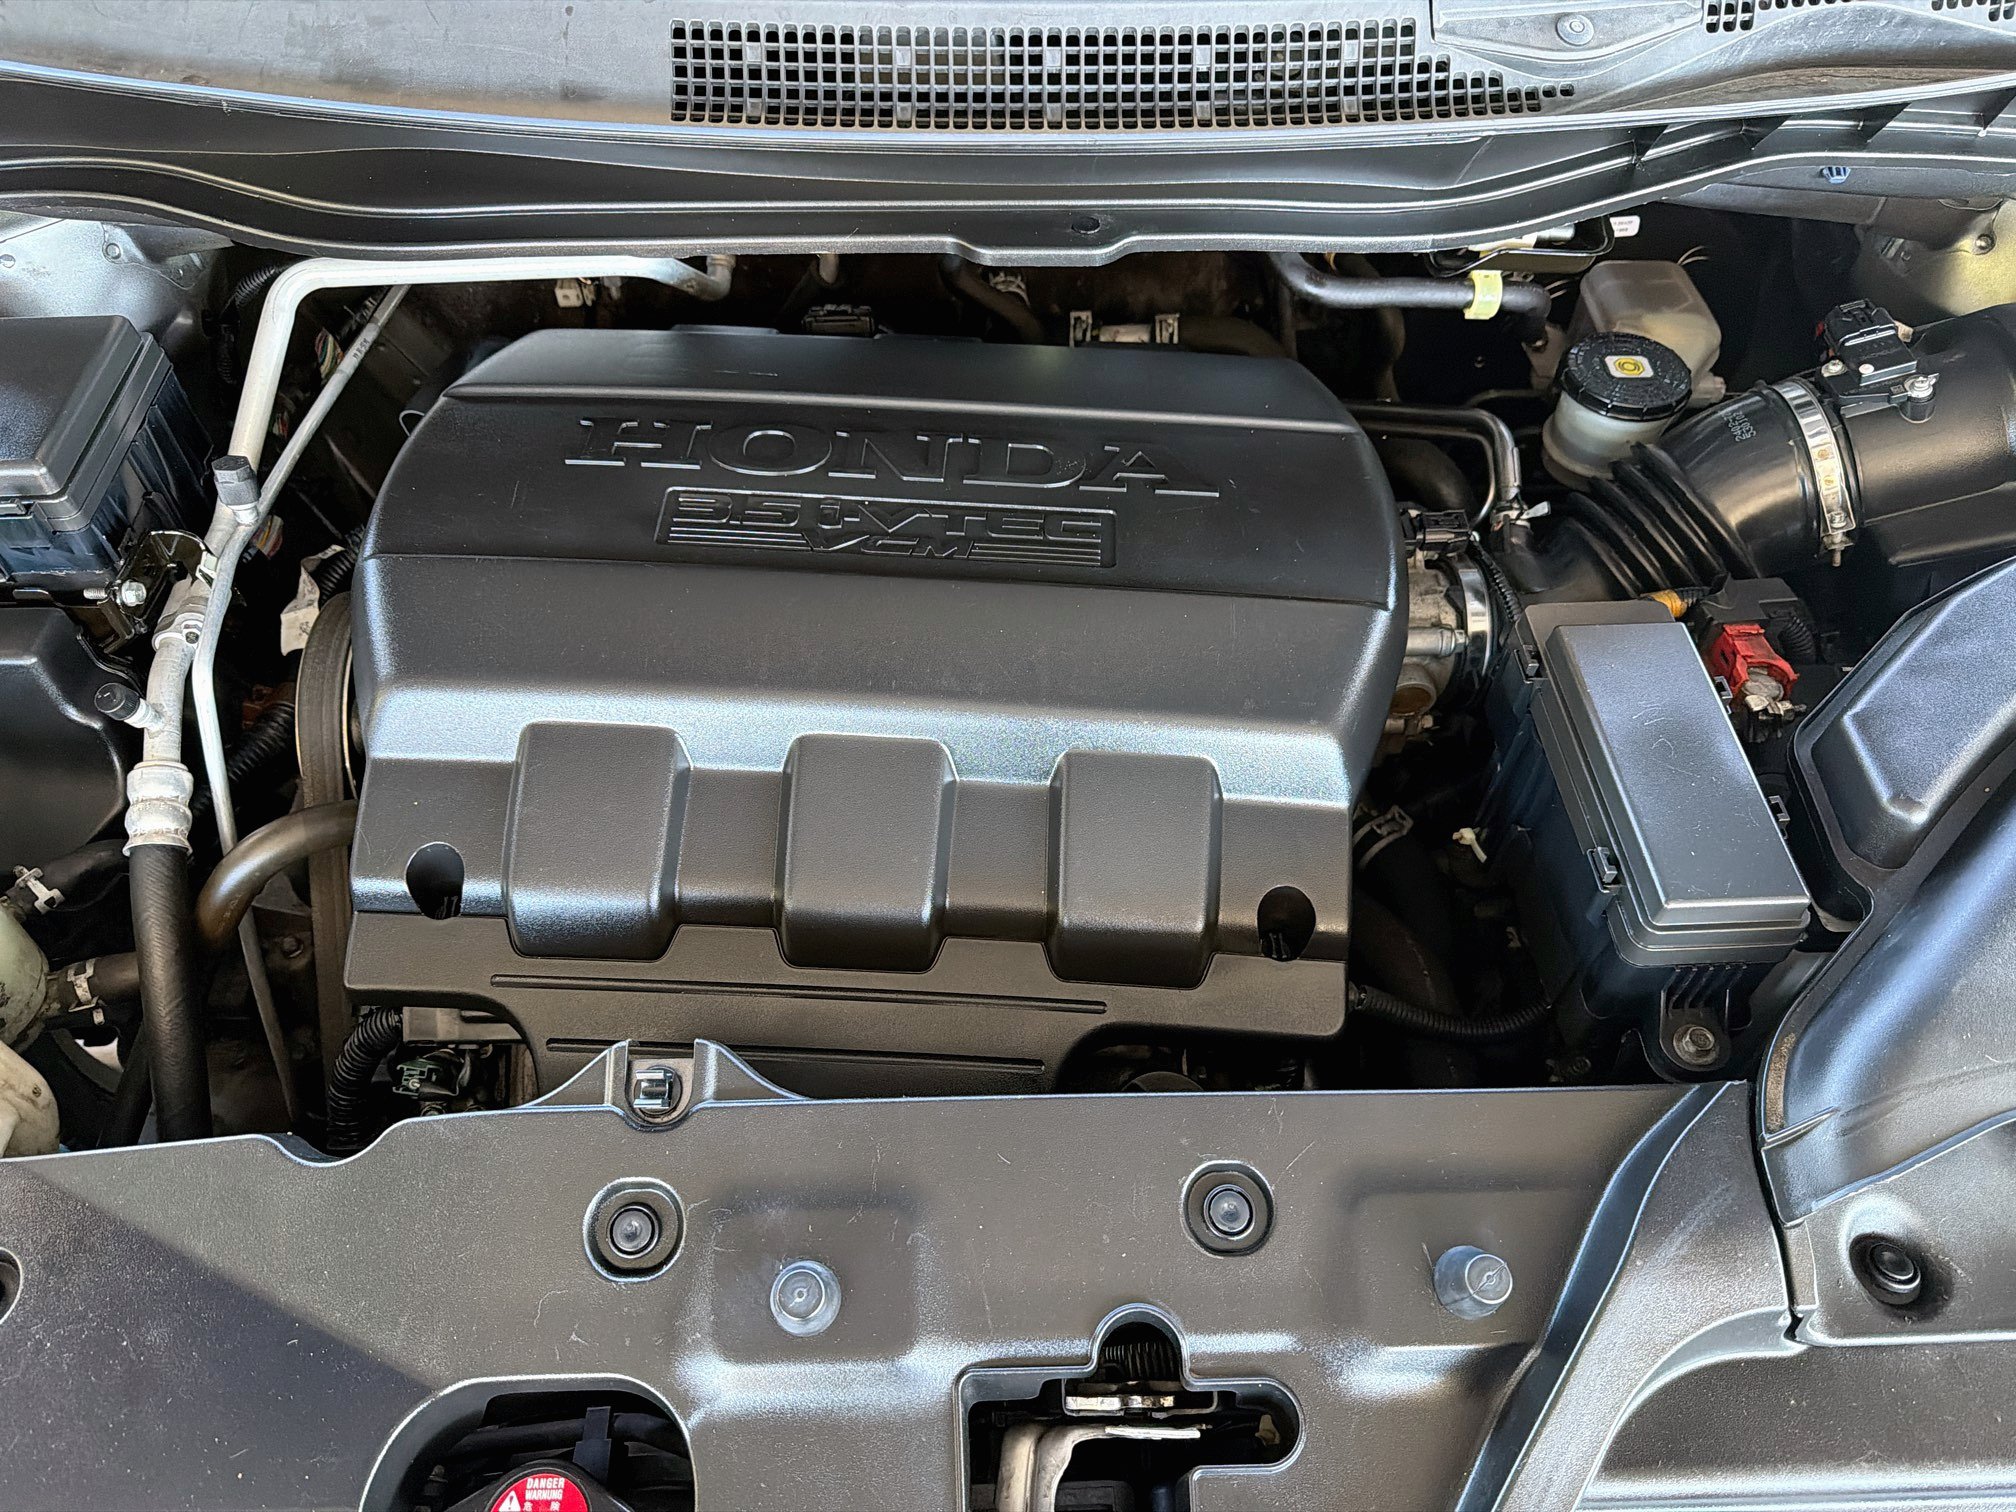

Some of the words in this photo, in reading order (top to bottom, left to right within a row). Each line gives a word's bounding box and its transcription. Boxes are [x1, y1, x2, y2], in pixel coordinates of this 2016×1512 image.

[564, 418, 1220, 498] HONDA
[672, 492, 801, 528] 3.5
[800, 530, 976, 560] VCM
[525, 1489, 564, 1501] WARNUNG
[526, 1477, 565, 1490] DANGER
